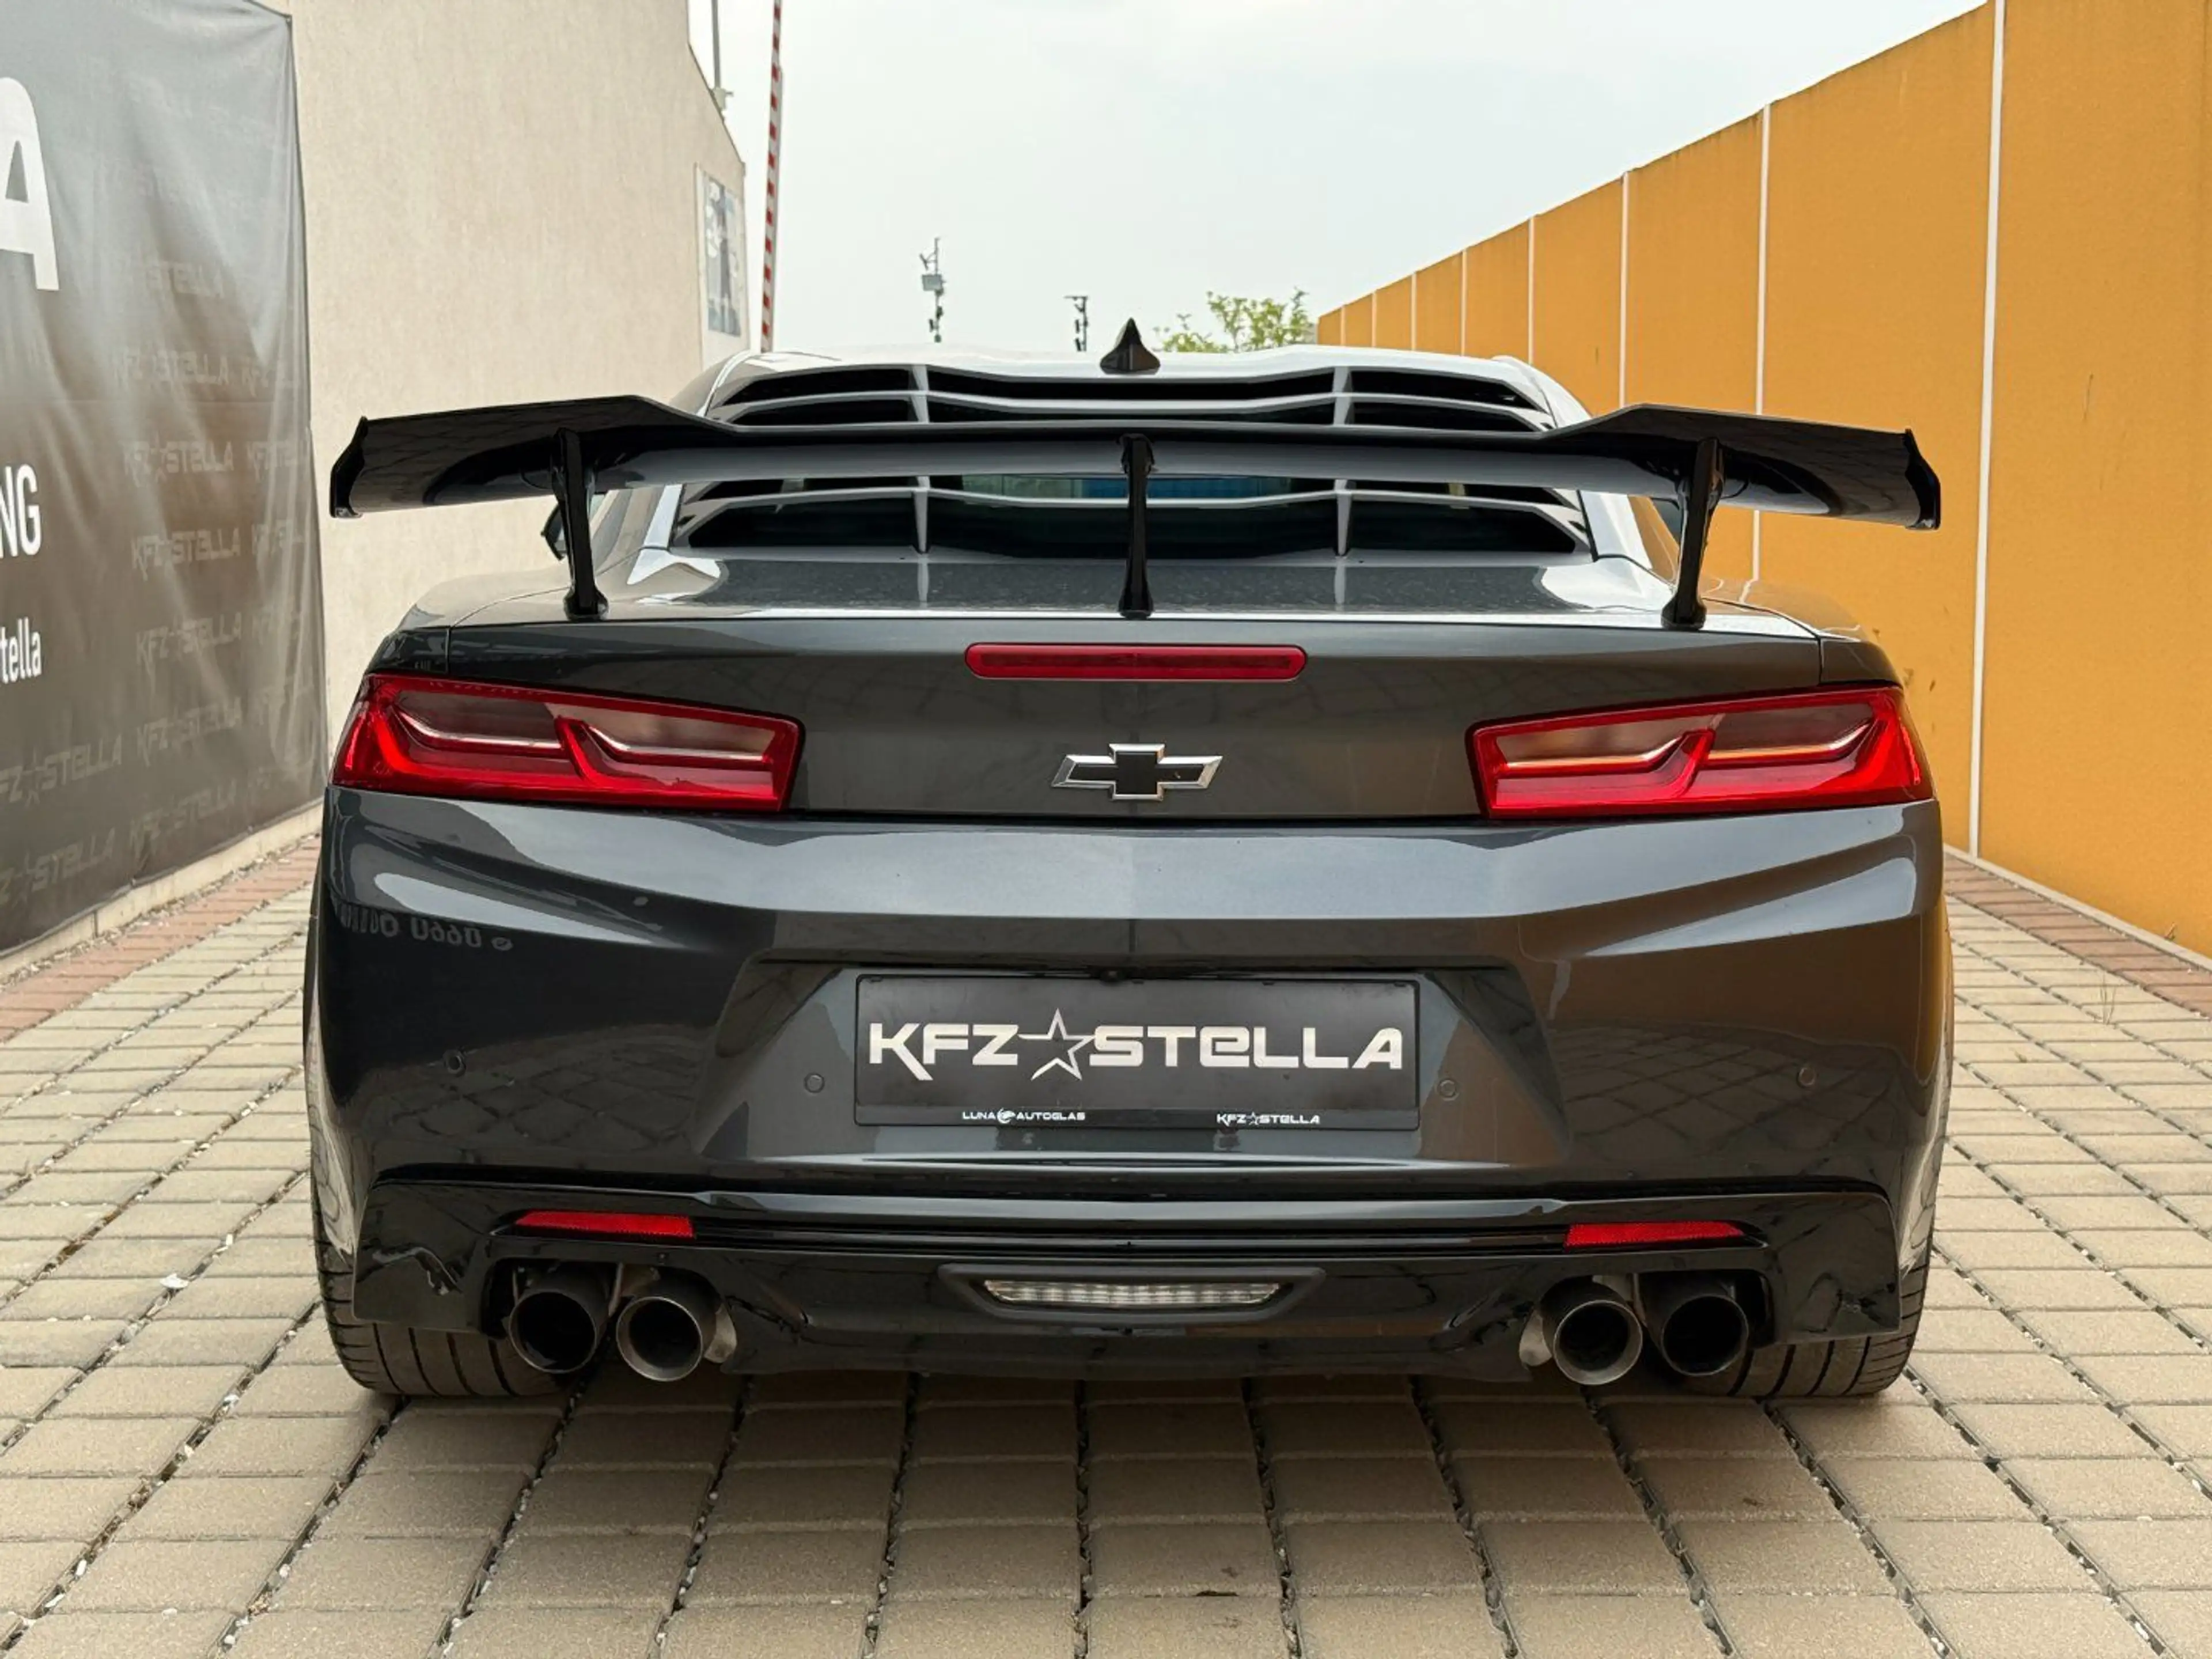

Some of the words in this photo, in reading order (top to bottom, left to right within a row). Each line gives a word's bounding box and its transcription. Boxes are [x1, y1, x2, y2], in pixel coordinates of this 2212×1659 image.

[869, 1022, 1018, 1081] KFZ
[962, 1111, 997, 1120] LUNA
[1016, 1111, 1085, 1121] AUTOGLAS
[1216, 1113, 1247, 1127] KFZ
